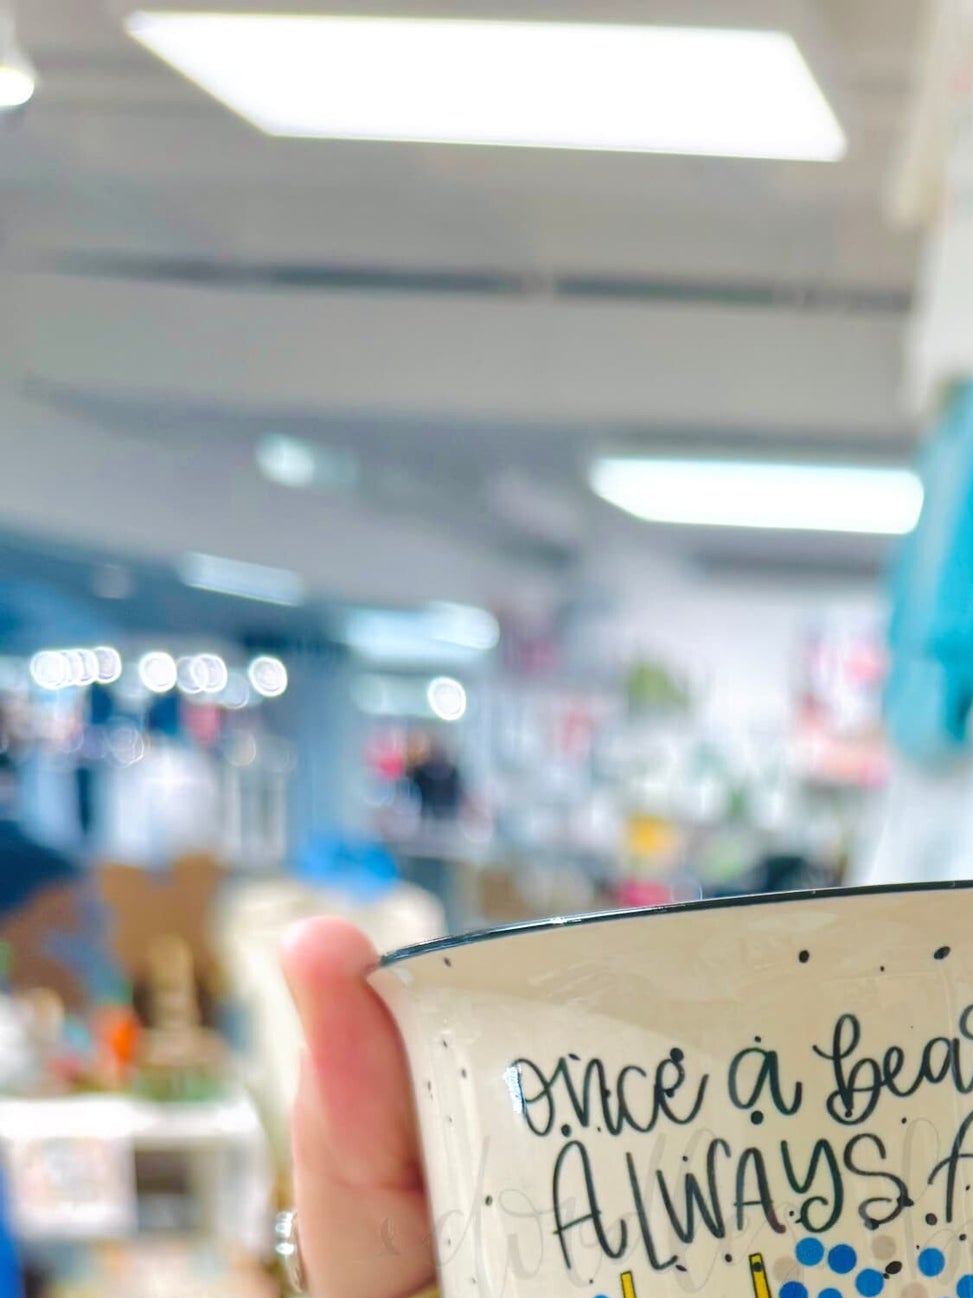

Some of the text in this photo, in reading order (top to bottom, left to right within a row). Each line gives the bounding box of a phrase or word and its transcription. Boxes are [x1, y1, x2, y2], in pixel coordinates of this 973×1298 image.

[512, 1050, 708, 1137] once
[727, 1046, 803, 1116] a
[552, 1132, 910, 1271] ALWAYS
